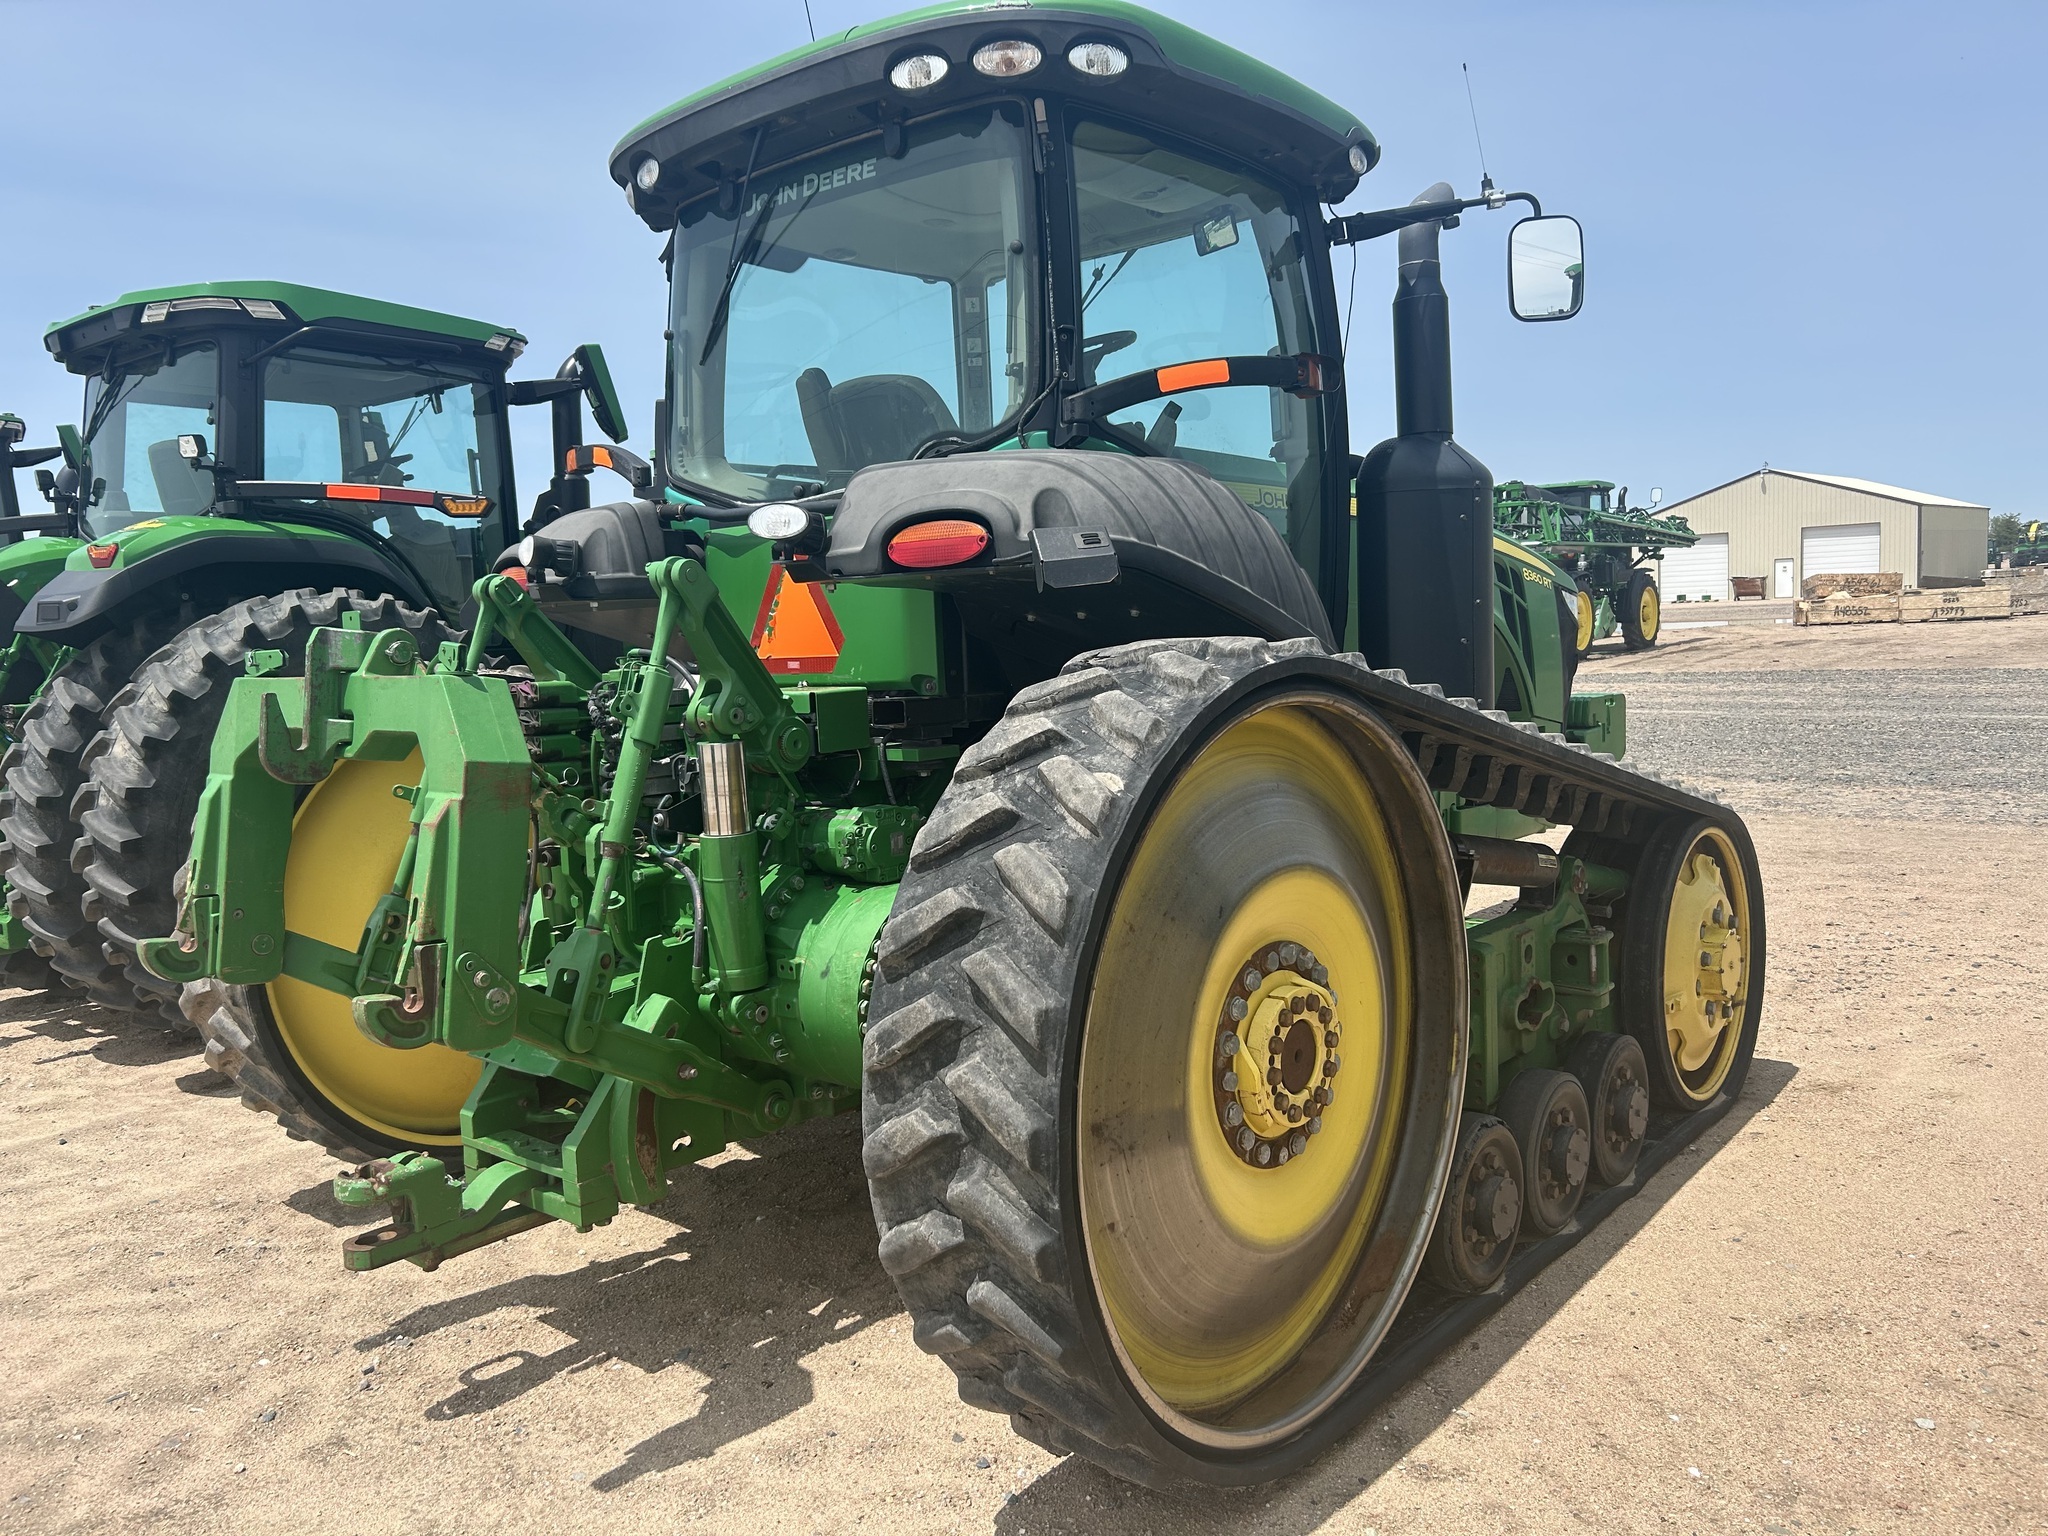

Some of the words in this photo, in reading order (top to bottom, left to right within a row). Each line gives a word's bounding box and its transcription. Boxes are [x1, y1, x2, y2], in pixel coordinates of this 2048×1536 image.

[803, 157, 877, 197] DEERE
[1254, 488, 1287, 509] JOH
[1522, 567, 1543, 585] 8360
[1542, 576, 1552, 590] RT
